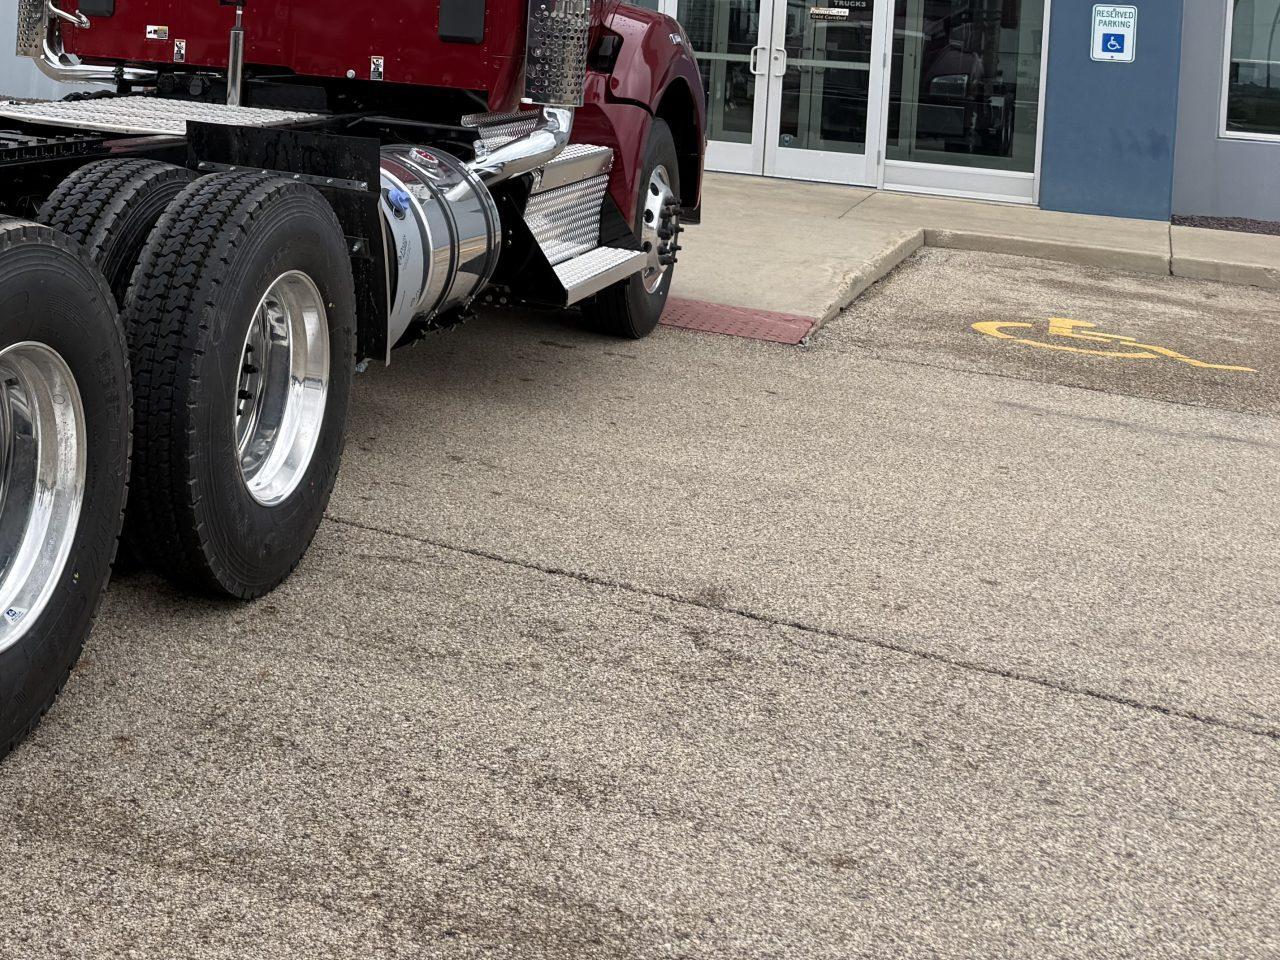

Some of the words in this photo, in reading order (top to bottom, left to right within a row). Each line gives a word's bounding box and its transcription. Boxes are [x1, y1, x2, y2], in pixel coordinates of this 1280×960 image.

[834, 0, 866, 8] TRUCKS
[1096, 10, 1134, 19] RESERVED
[1098, 20, 1131, 29] PARKING
